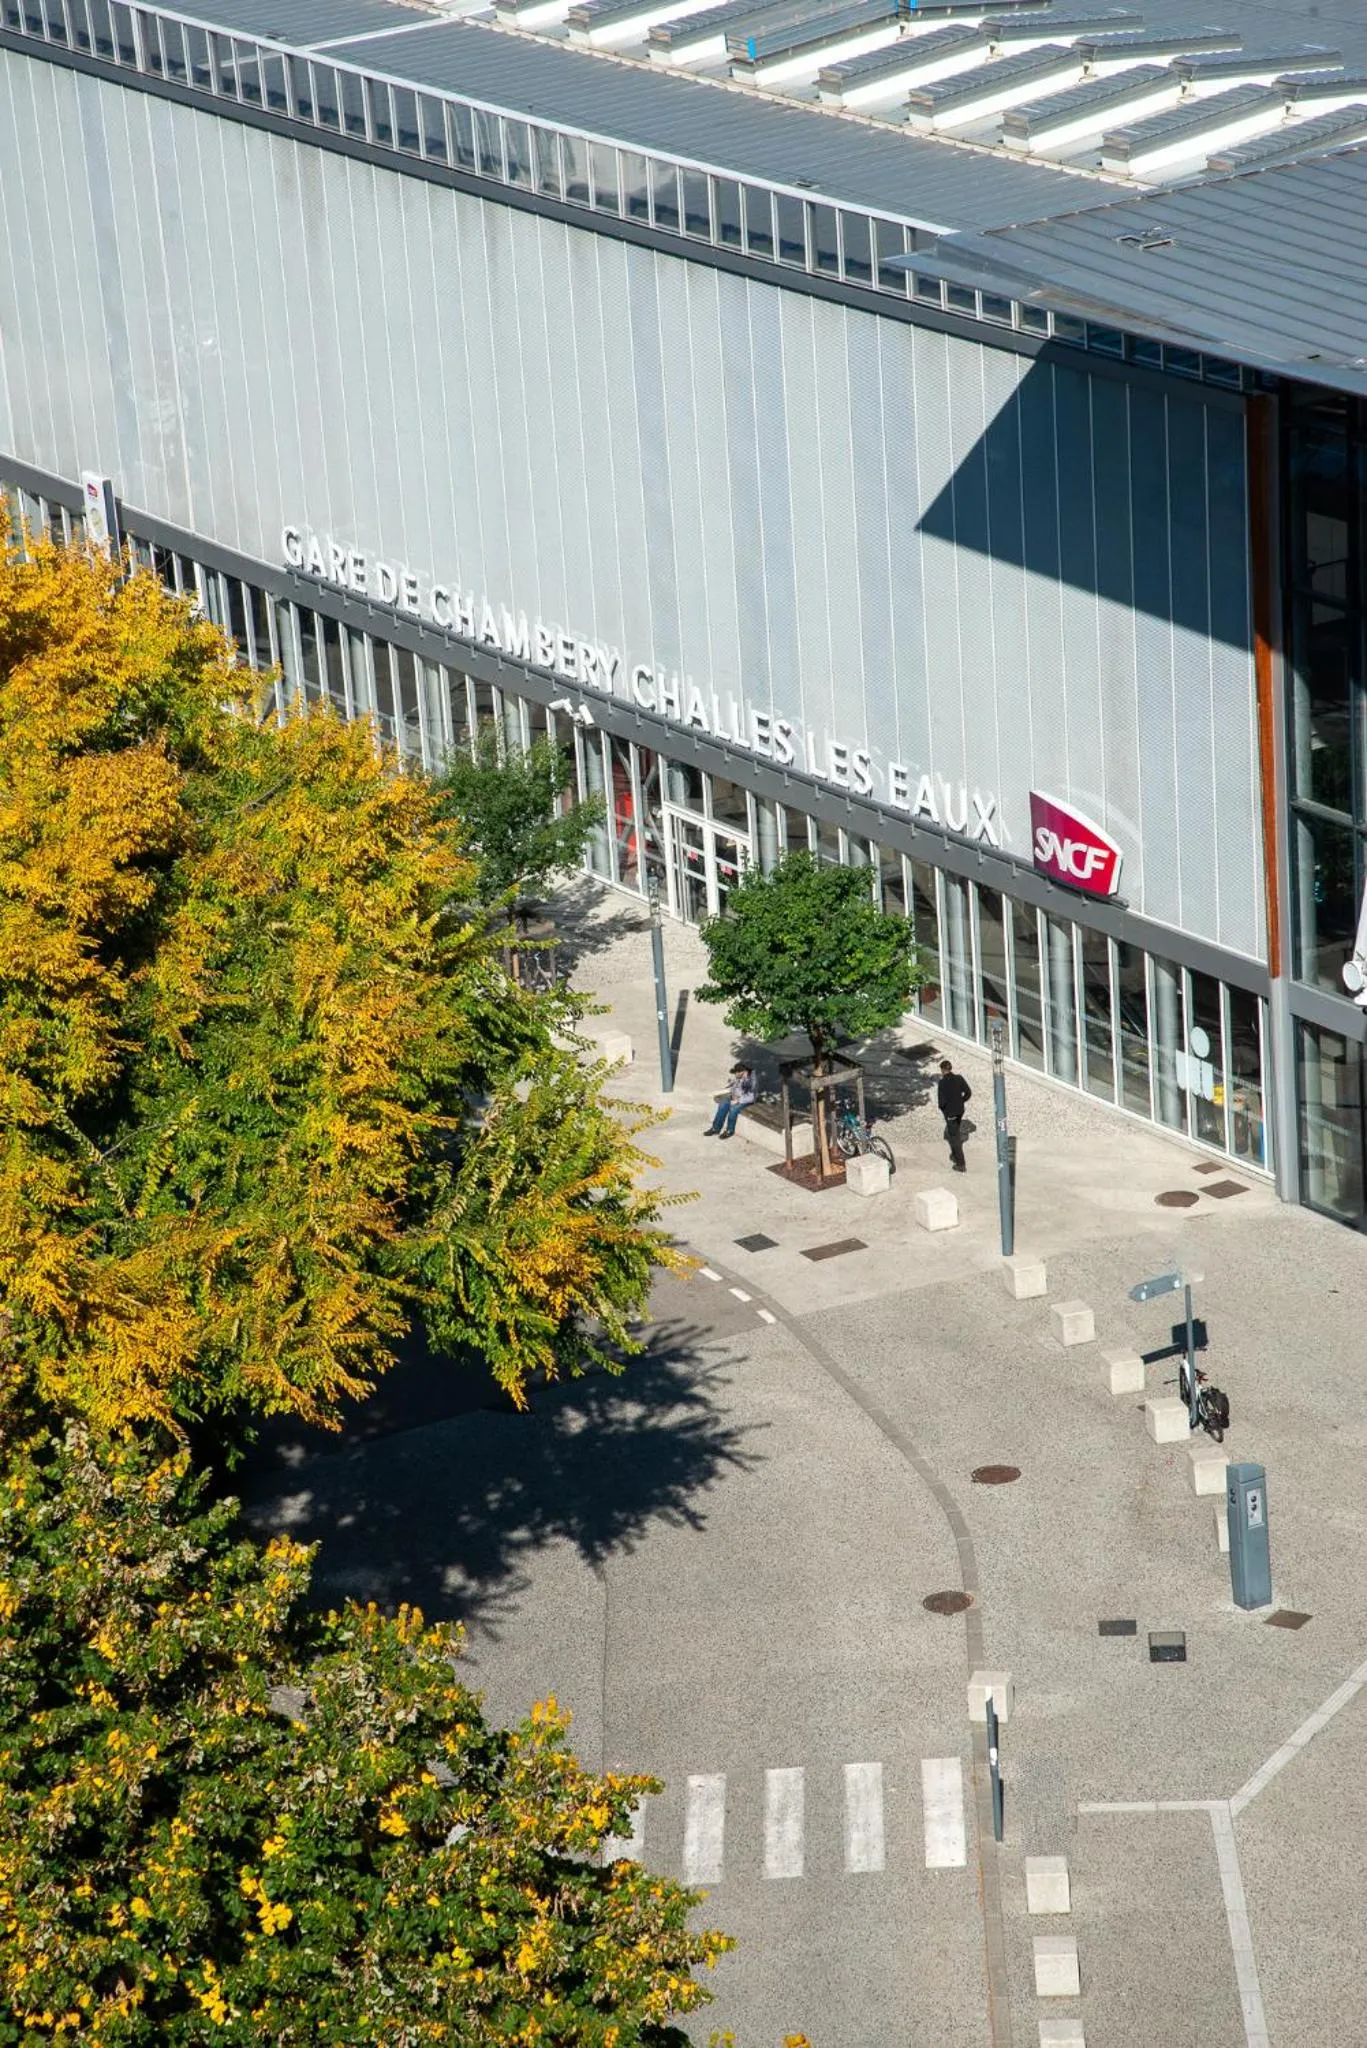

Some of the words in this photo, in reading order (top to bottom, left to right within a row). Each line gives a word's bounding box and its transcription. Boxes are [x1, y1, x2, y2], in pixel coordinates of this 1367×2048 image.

[281, 525, 368, 594] GARE
[376, 562, 421, 614] DE
[430, 584, 620, 695] CHAMBERY
[632, 664, 795, 765] CHALLES
[807, 731, 873, 796] LES
[888, 761, 1001, 848] EAUX
[1034, 827, 1109, 879] SNCF
